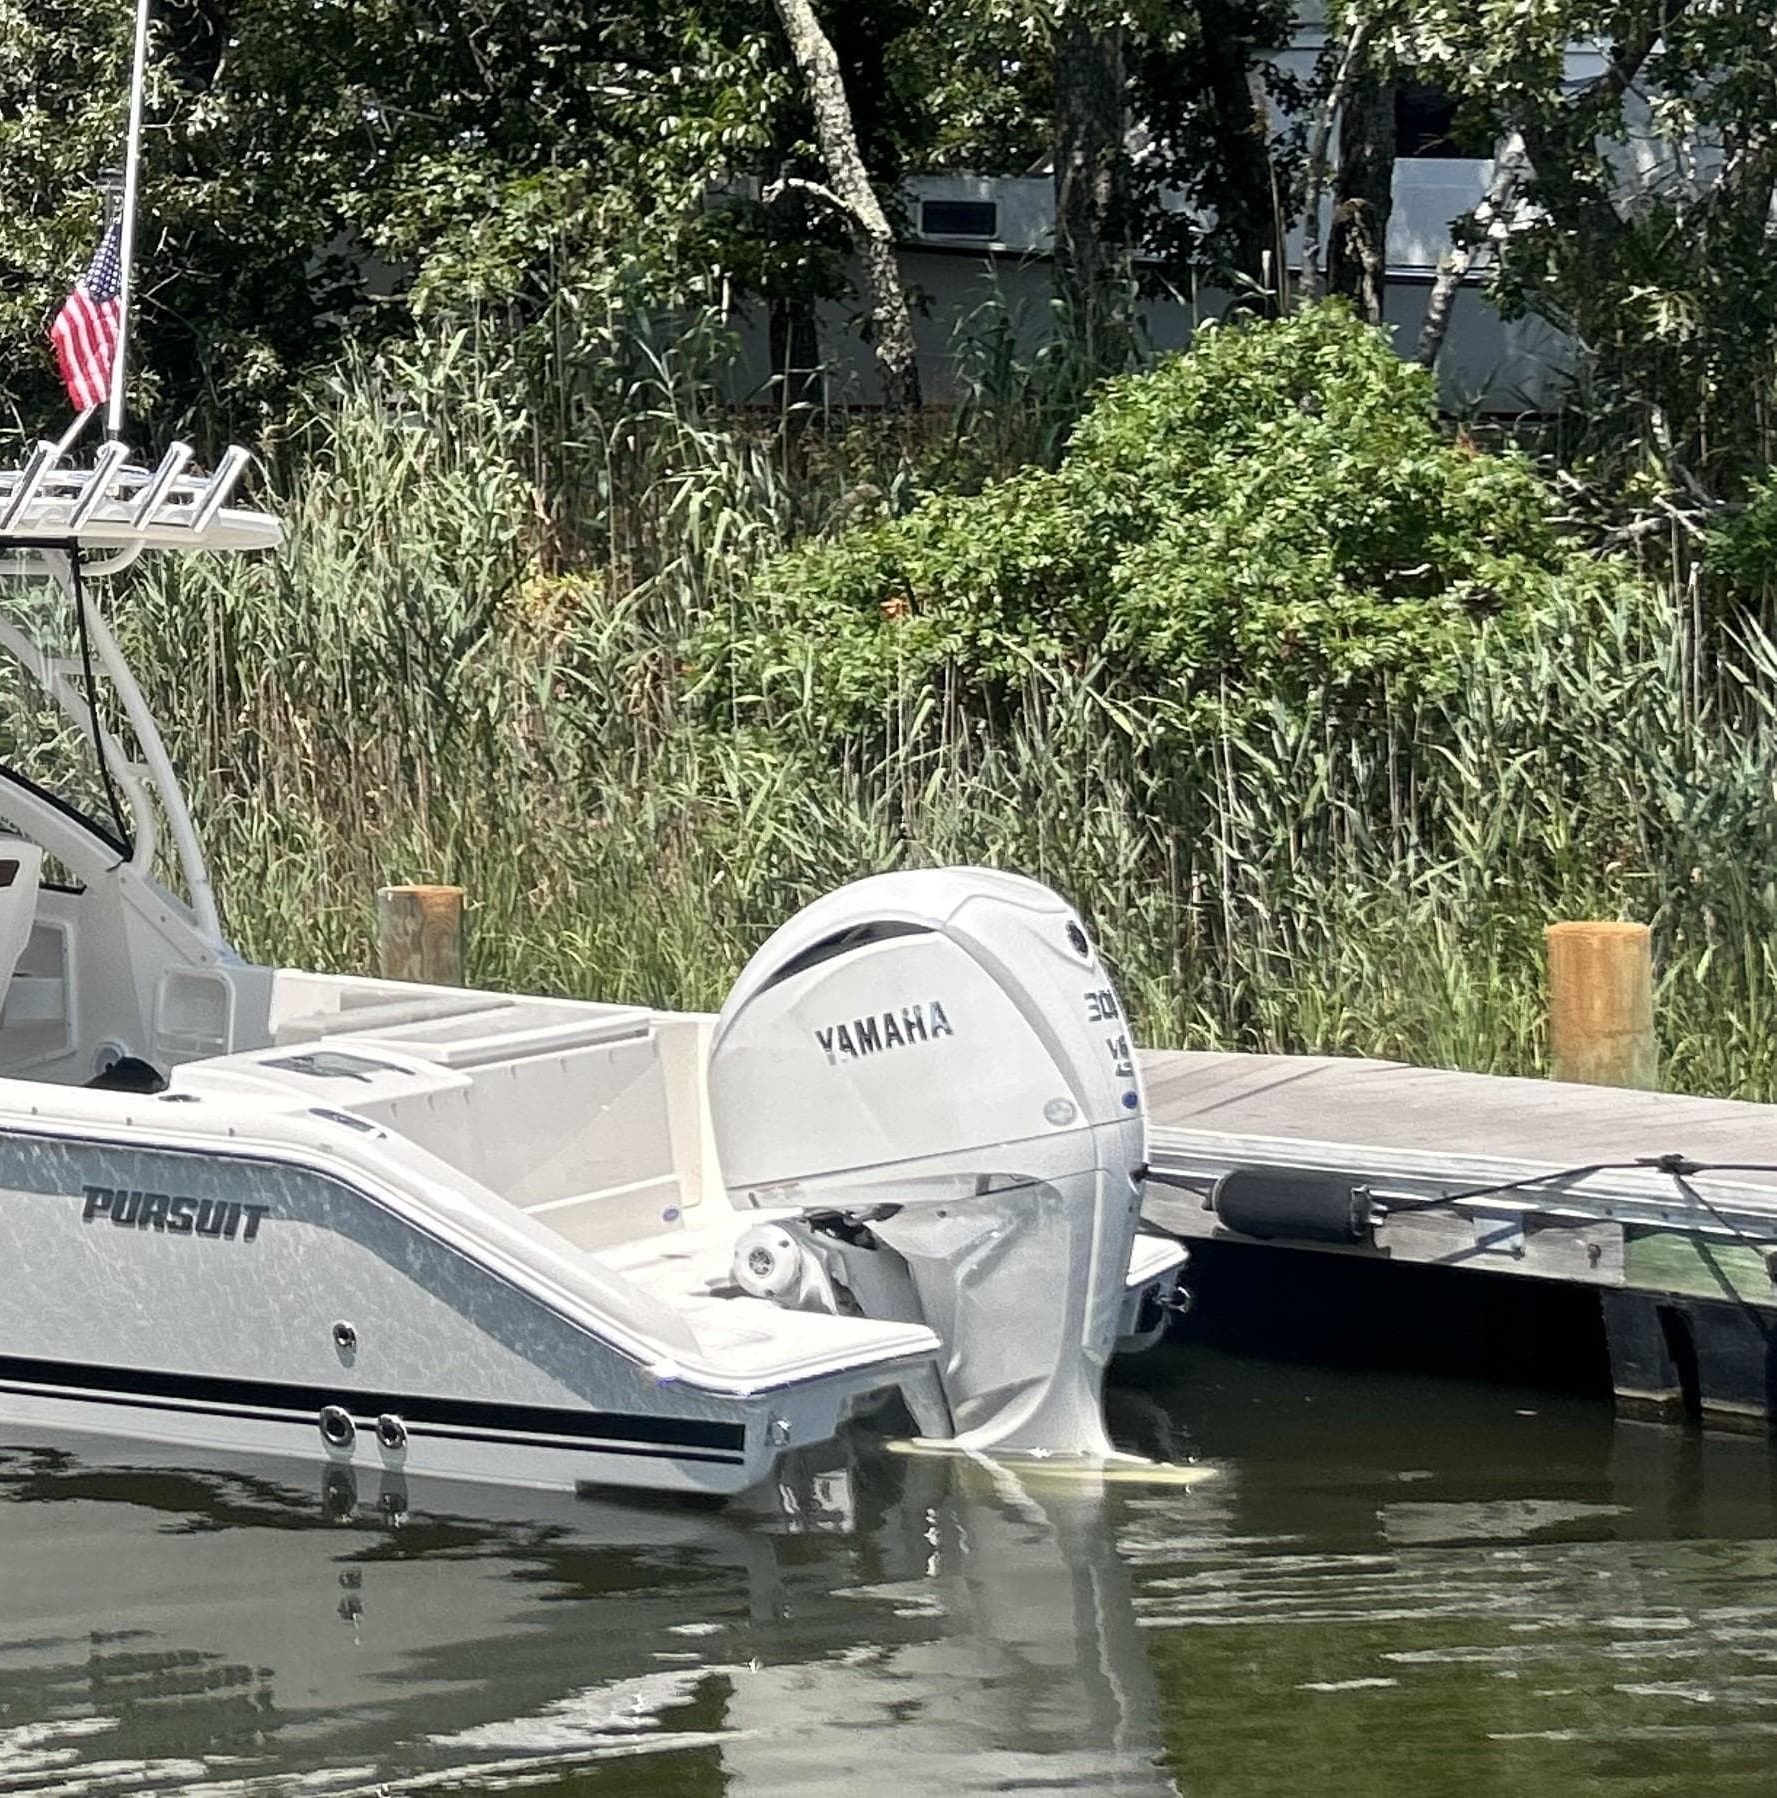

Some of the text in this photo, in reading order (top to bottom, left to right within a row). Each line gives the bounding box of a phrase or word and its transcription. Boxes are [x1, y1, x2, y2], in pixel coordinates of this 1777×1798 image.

[815, 1000, 953, 1065] YAMAHA
[1084, 989, 1119, 1022] 30
[81, 1185, 270, 1243] PURSUIT
